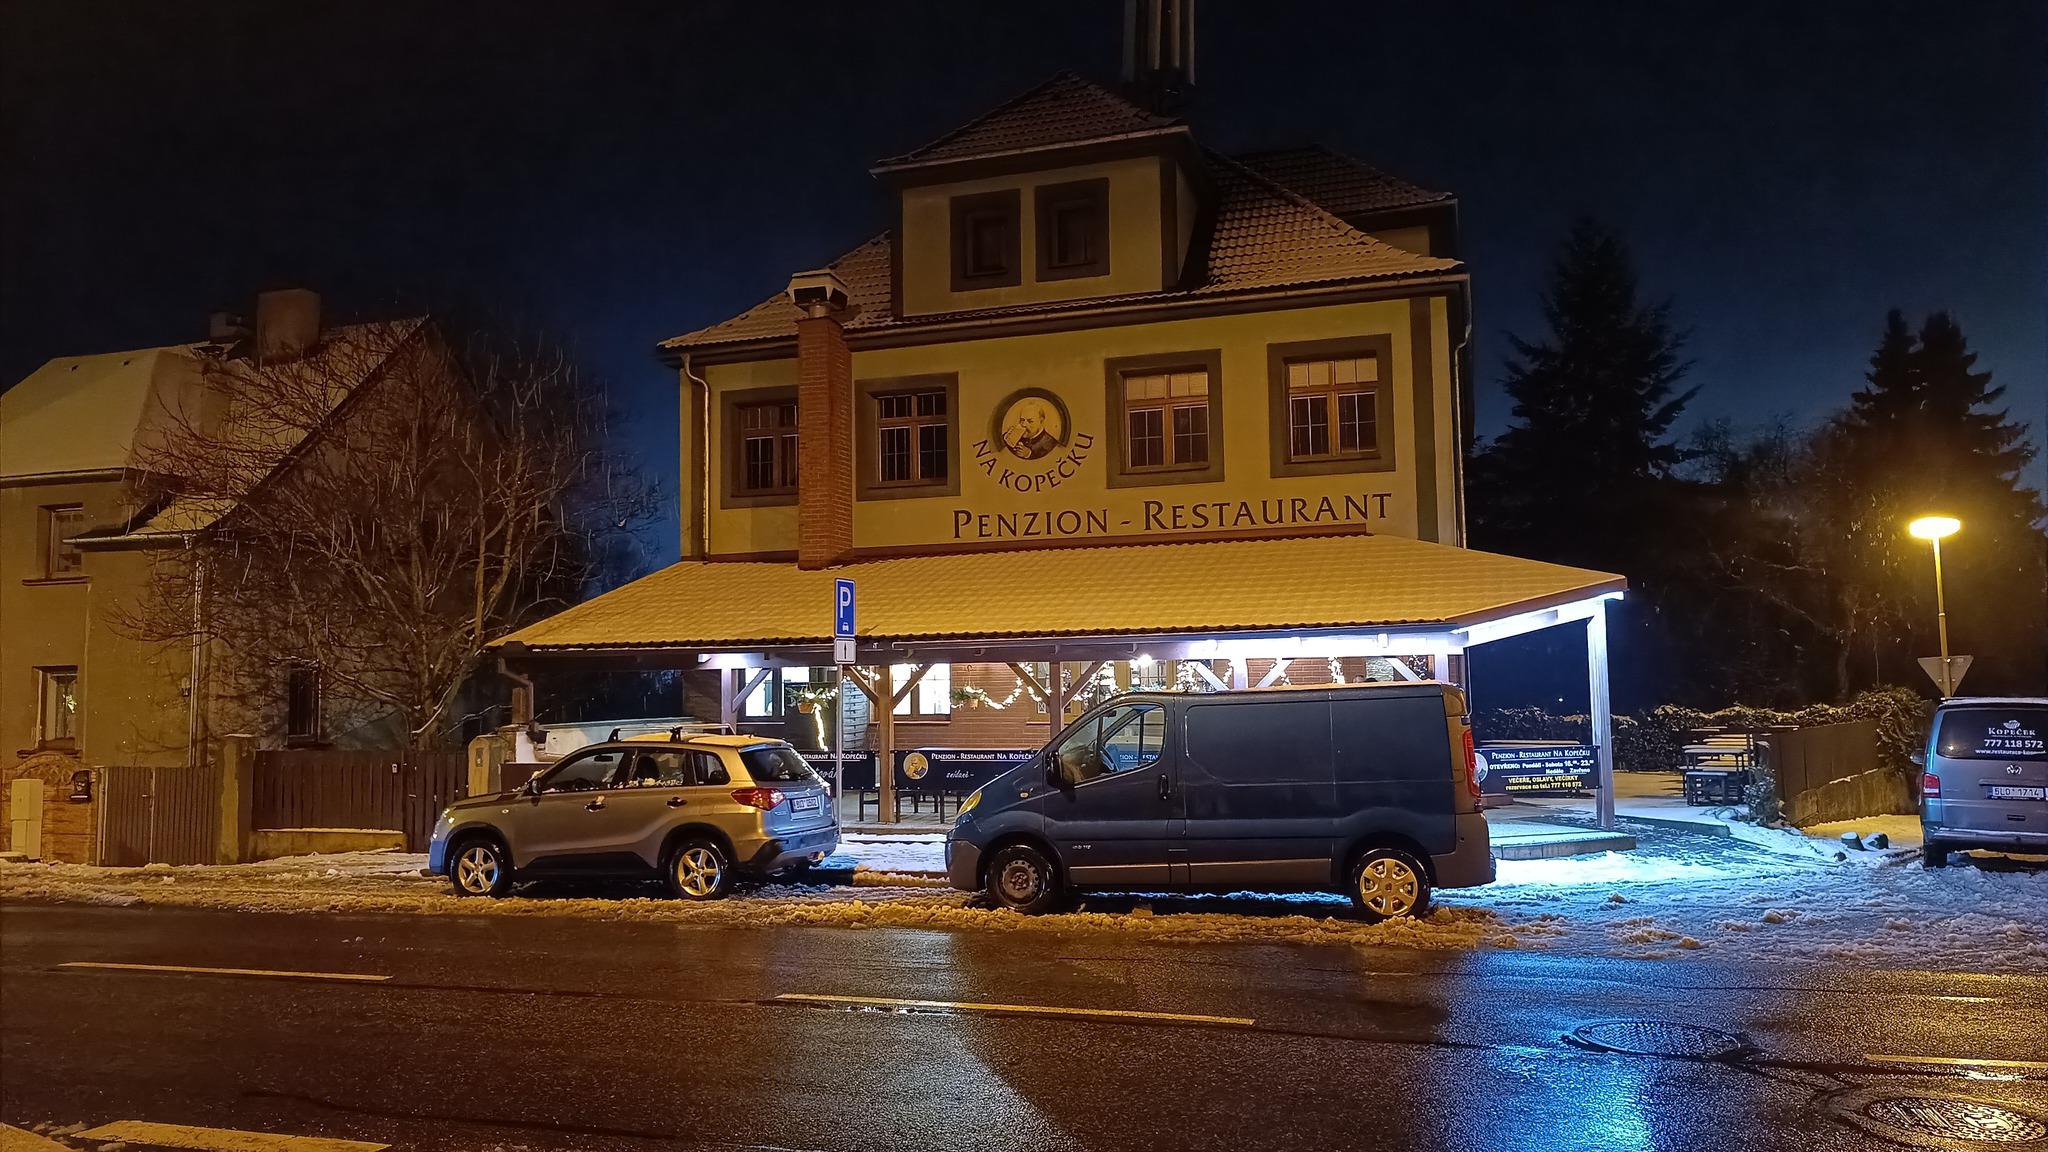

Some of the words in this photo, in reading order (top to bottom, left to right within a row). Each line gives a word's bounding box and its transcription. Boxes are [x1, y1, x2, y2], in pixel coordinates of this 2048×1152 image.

[972, 439, 998, 476] NA
[998, 432, 1095, 493] KOPEČKU
[839, 586, 851, 618] P
[1988, 727, 2036, 736] KOPEČEK
[1984, 739, 2002, 747] 777
[2004, 740, 2023, 748] 118
[2024, 740, 2044, 748] 572
[997, 752, 1008, 760] NA
